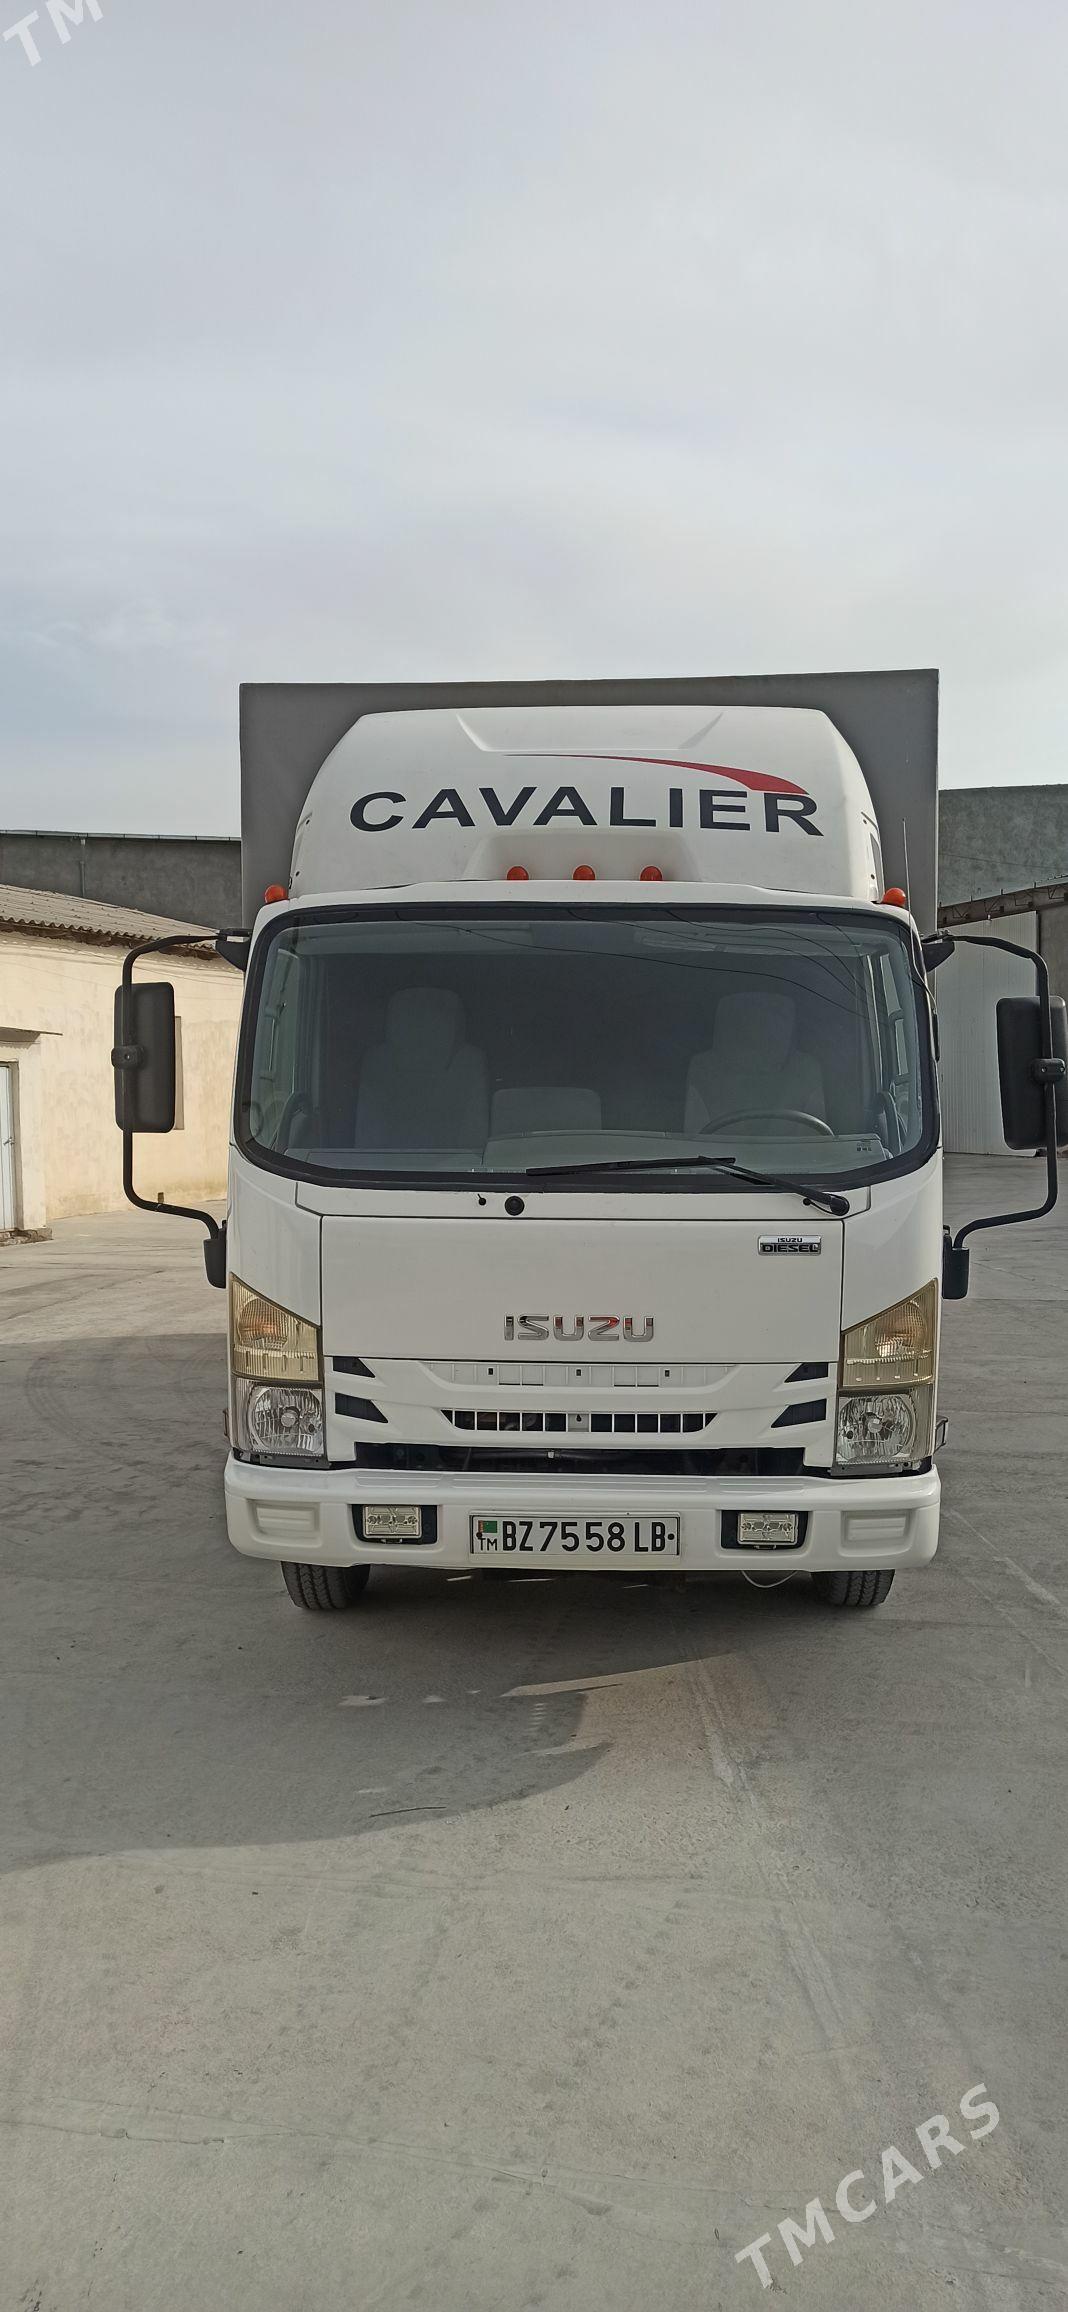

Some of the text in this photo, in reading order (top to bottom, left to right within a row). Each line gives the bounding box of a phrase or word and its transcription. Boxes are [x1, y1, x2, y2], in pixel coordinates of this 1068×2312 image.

[349, 786, 824, 837] CAVALIER
[762, 1244, 819, 1253] DIESEL
[503, 1315, 655, 1343] ISUZU
[479, 1537, 498, 1551] TM
[633, 1521, 667, 1553] LB
